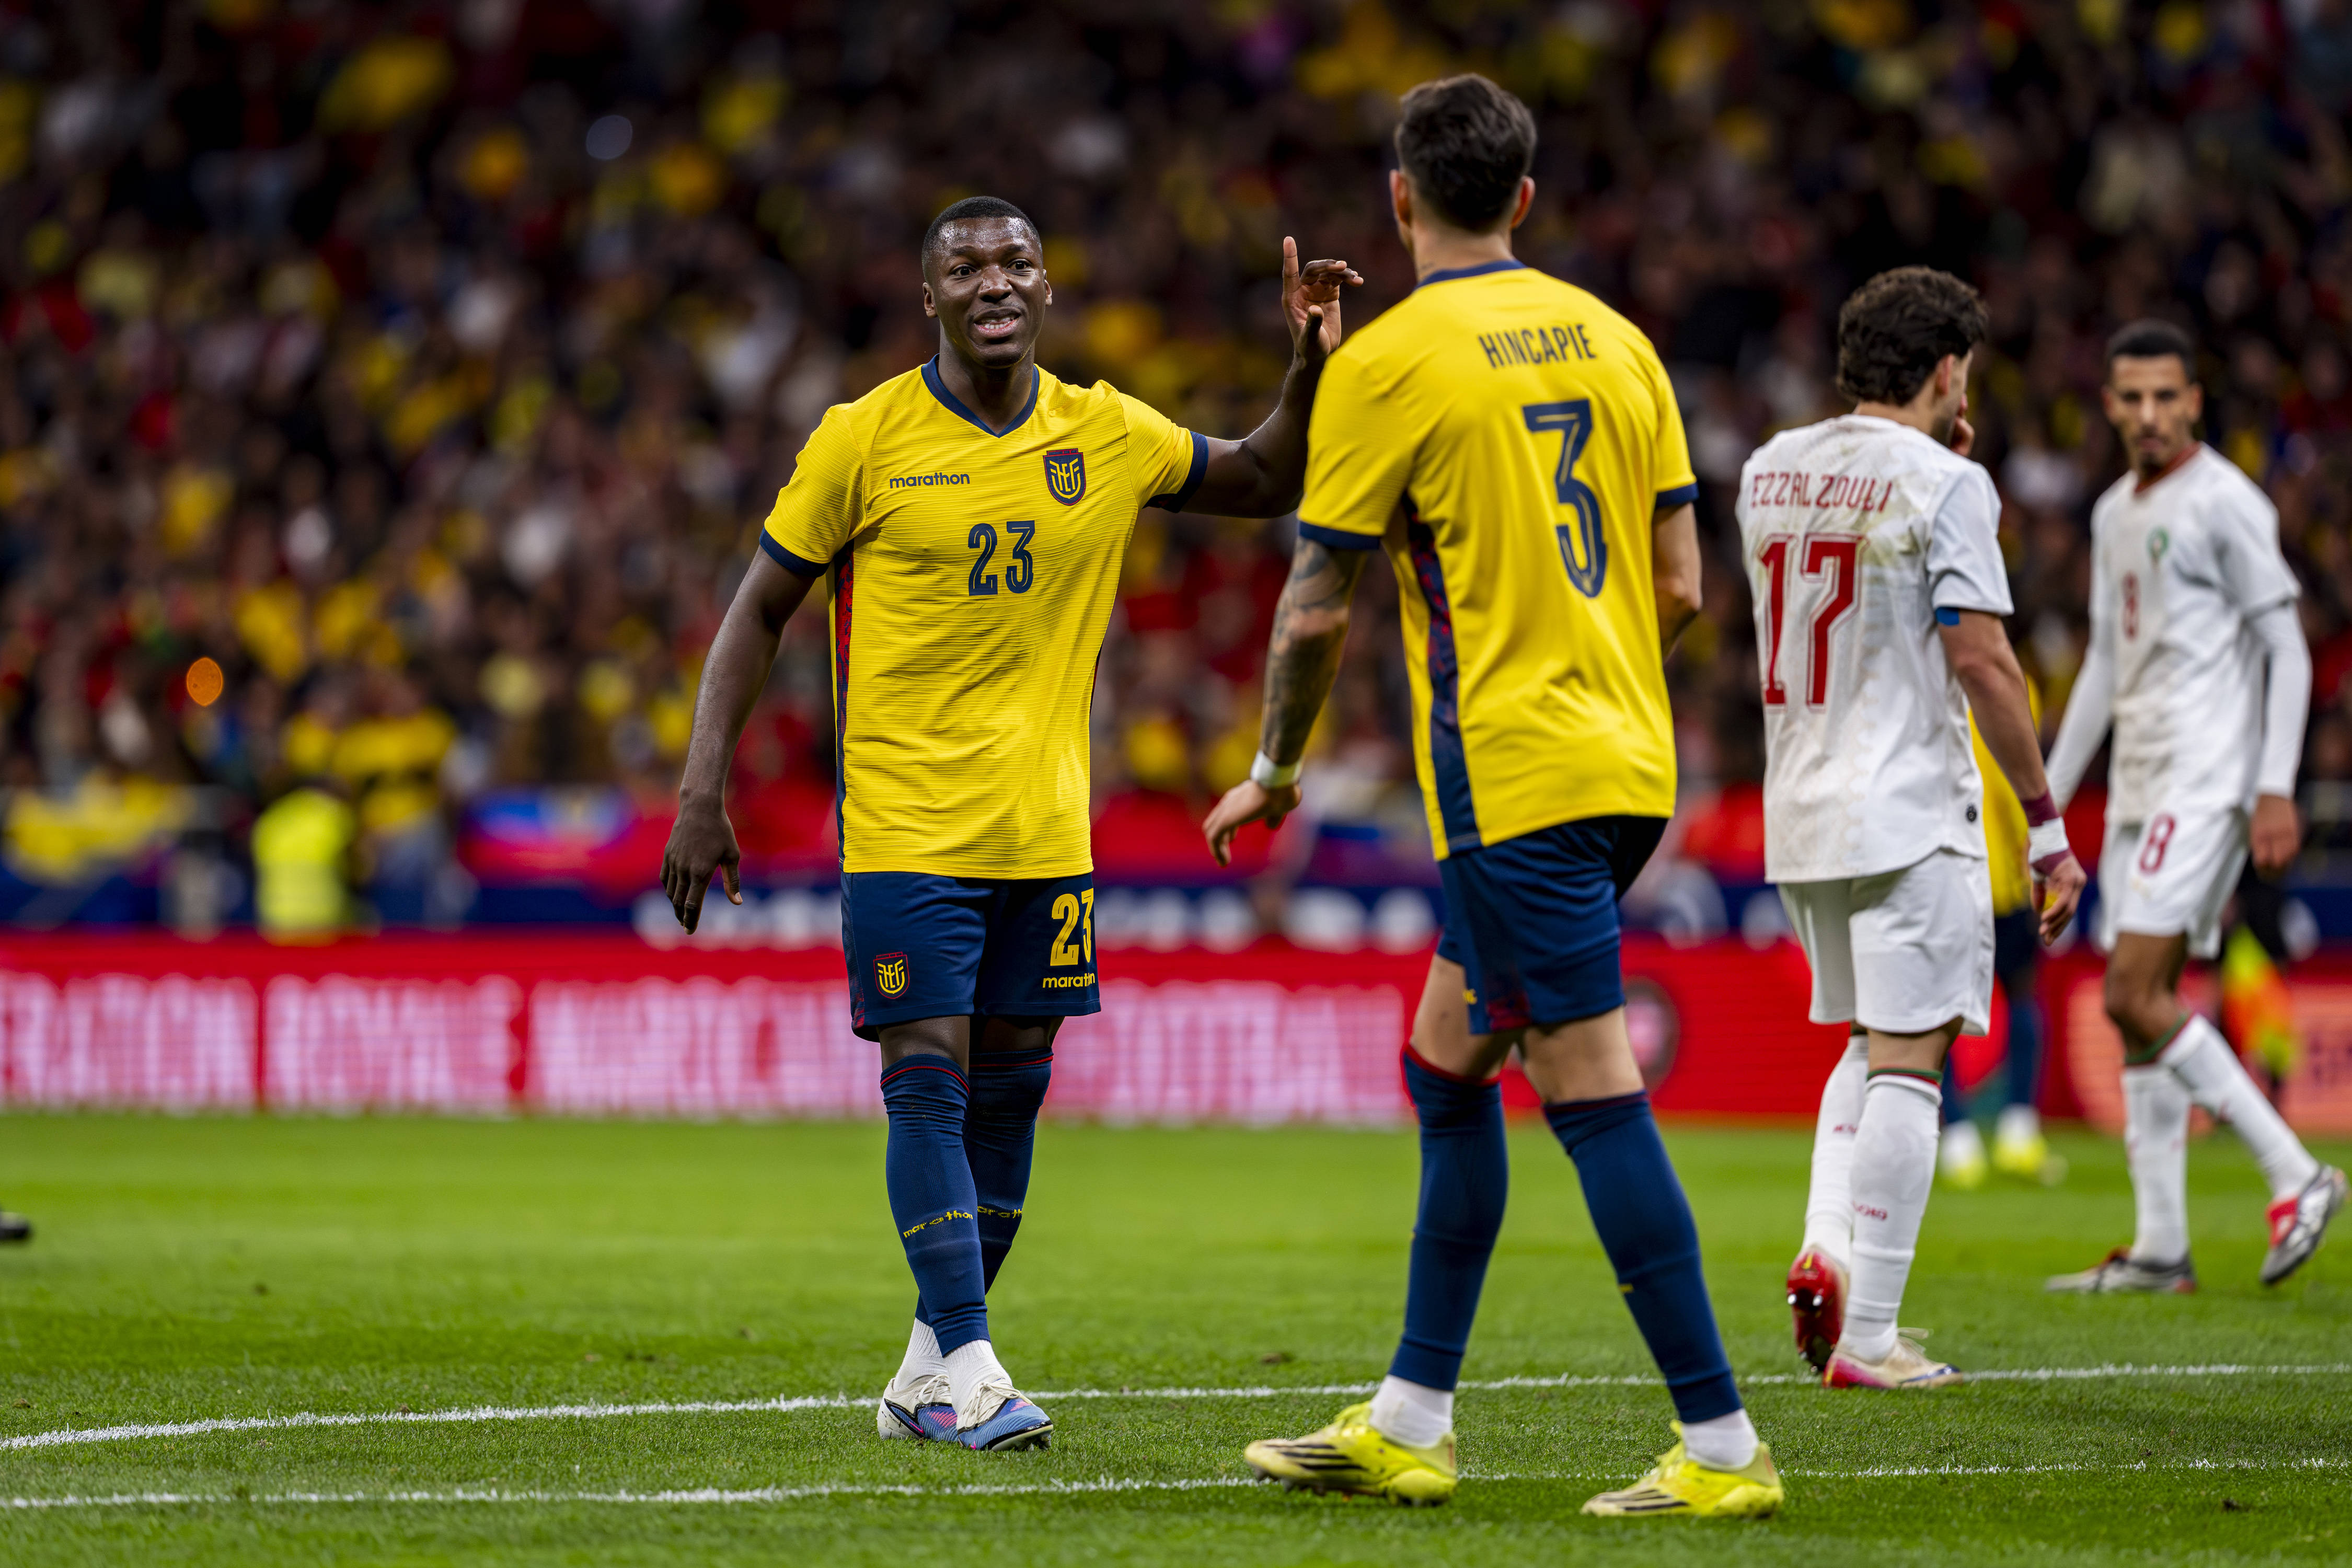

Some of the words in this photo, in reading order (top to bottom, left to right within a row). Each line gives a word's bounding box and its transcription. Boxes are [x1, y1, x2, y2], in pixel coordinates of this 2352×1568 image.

[1478, 323, 1597, 369] HINCAPIE
[890, 472, 970, 489] marathon
[1521, 398, 1608, 599] 3
[967, 520, 1035, 596] 23
[1756, 532, 1870, 712] 17
[2139, 813, 2176, 875] 8
[1050, 887, 1094, 966] 23
